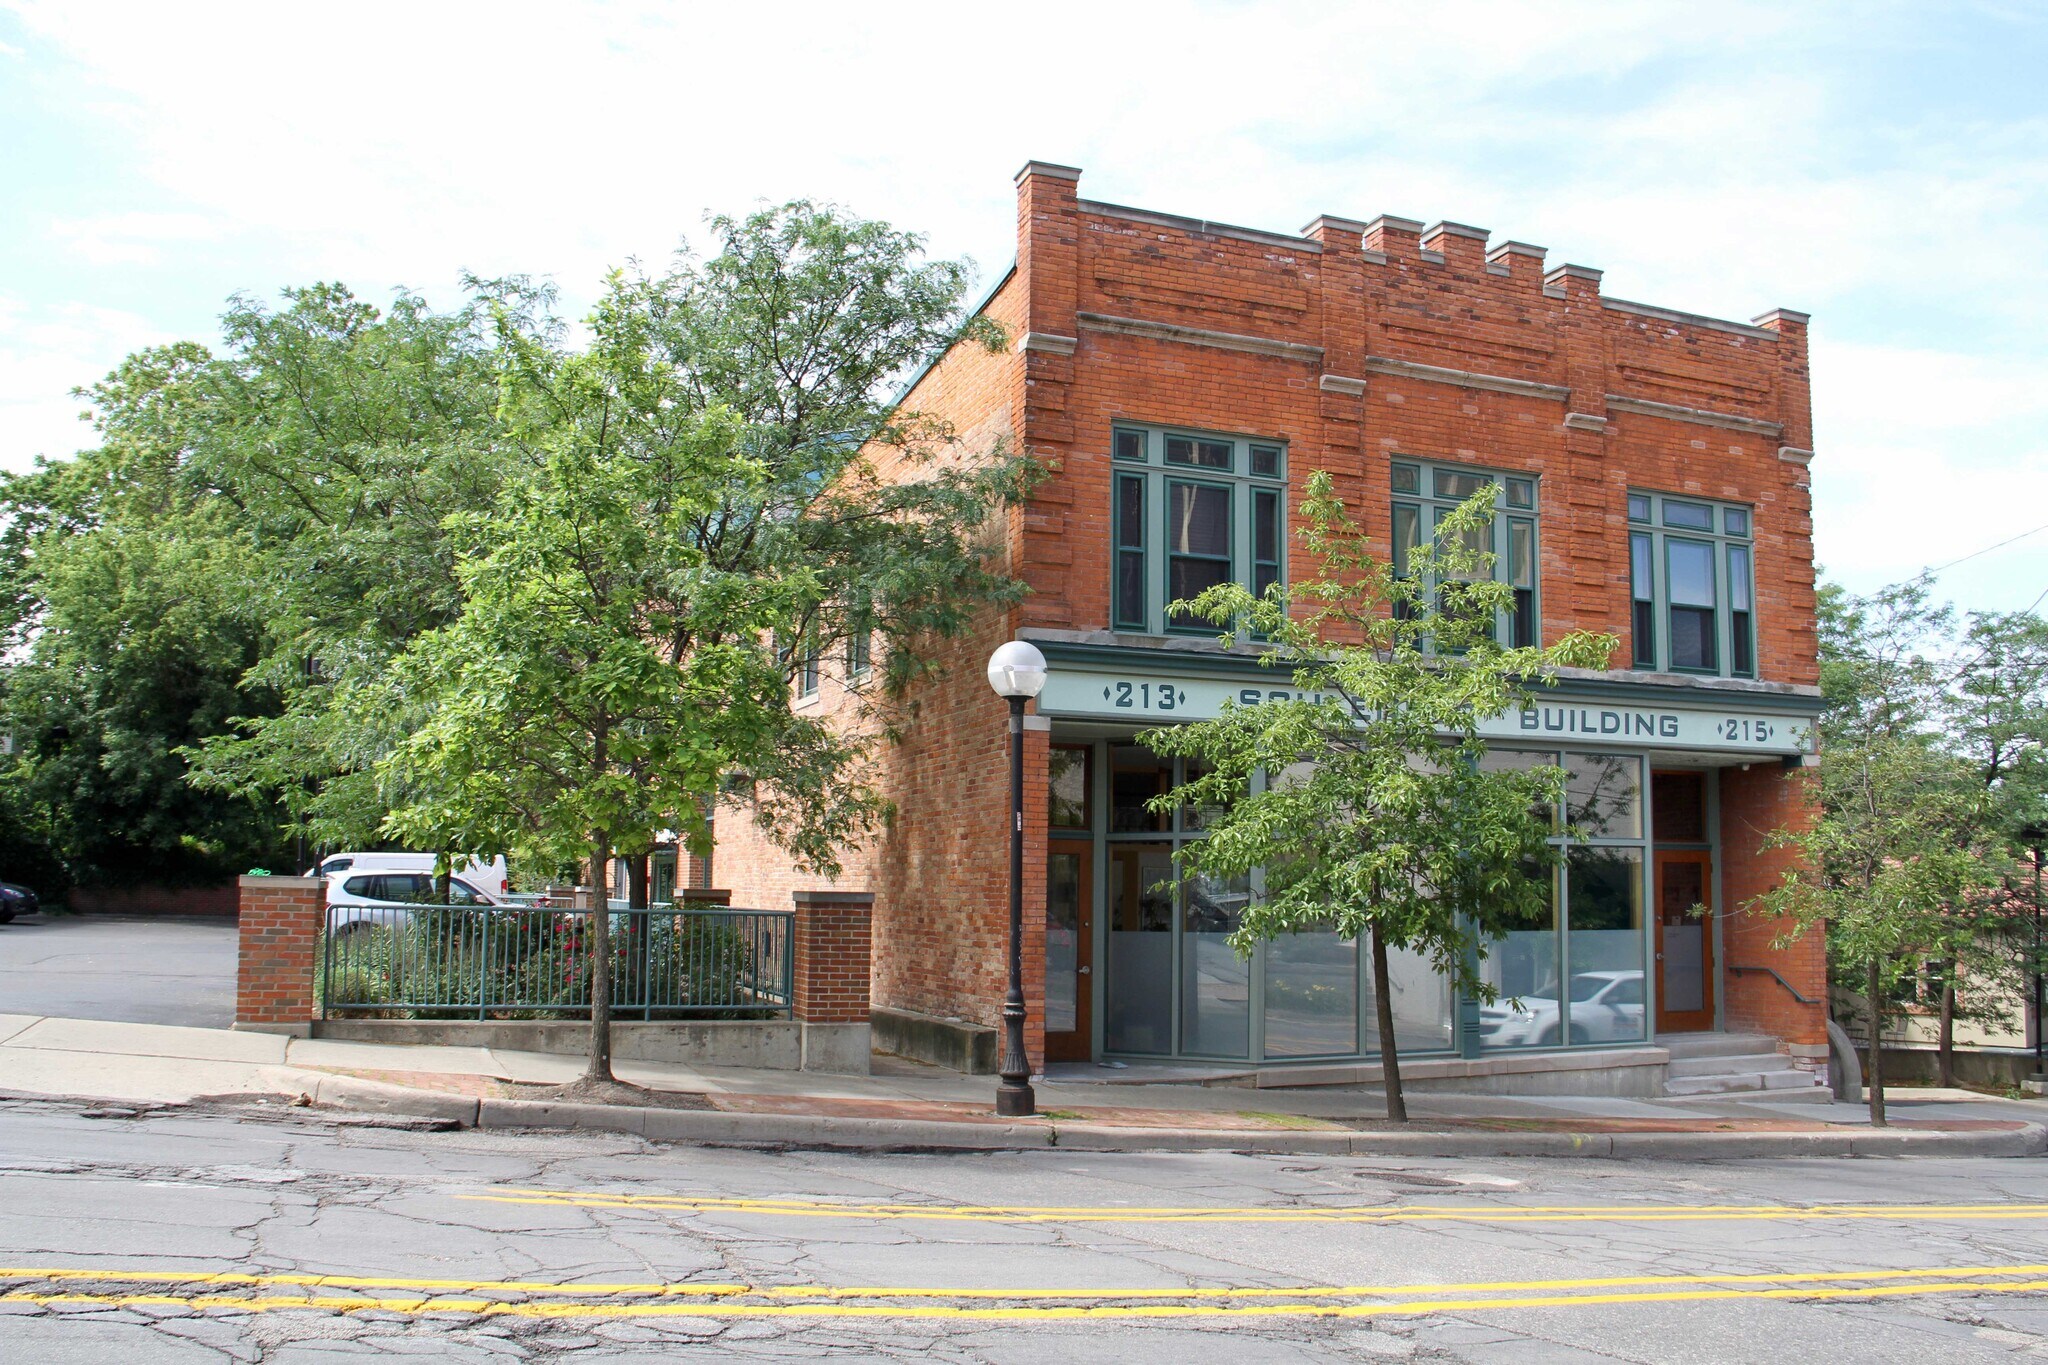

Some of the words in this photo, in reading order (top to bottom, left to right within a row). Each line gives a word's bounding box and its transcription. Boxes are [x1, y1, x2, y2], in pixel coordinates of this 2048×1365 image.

[1115, 682, 1175, 710] 213
[1520, 707, 1679, 737] BUILDING
[1726, 718, 1767, 741] 215
